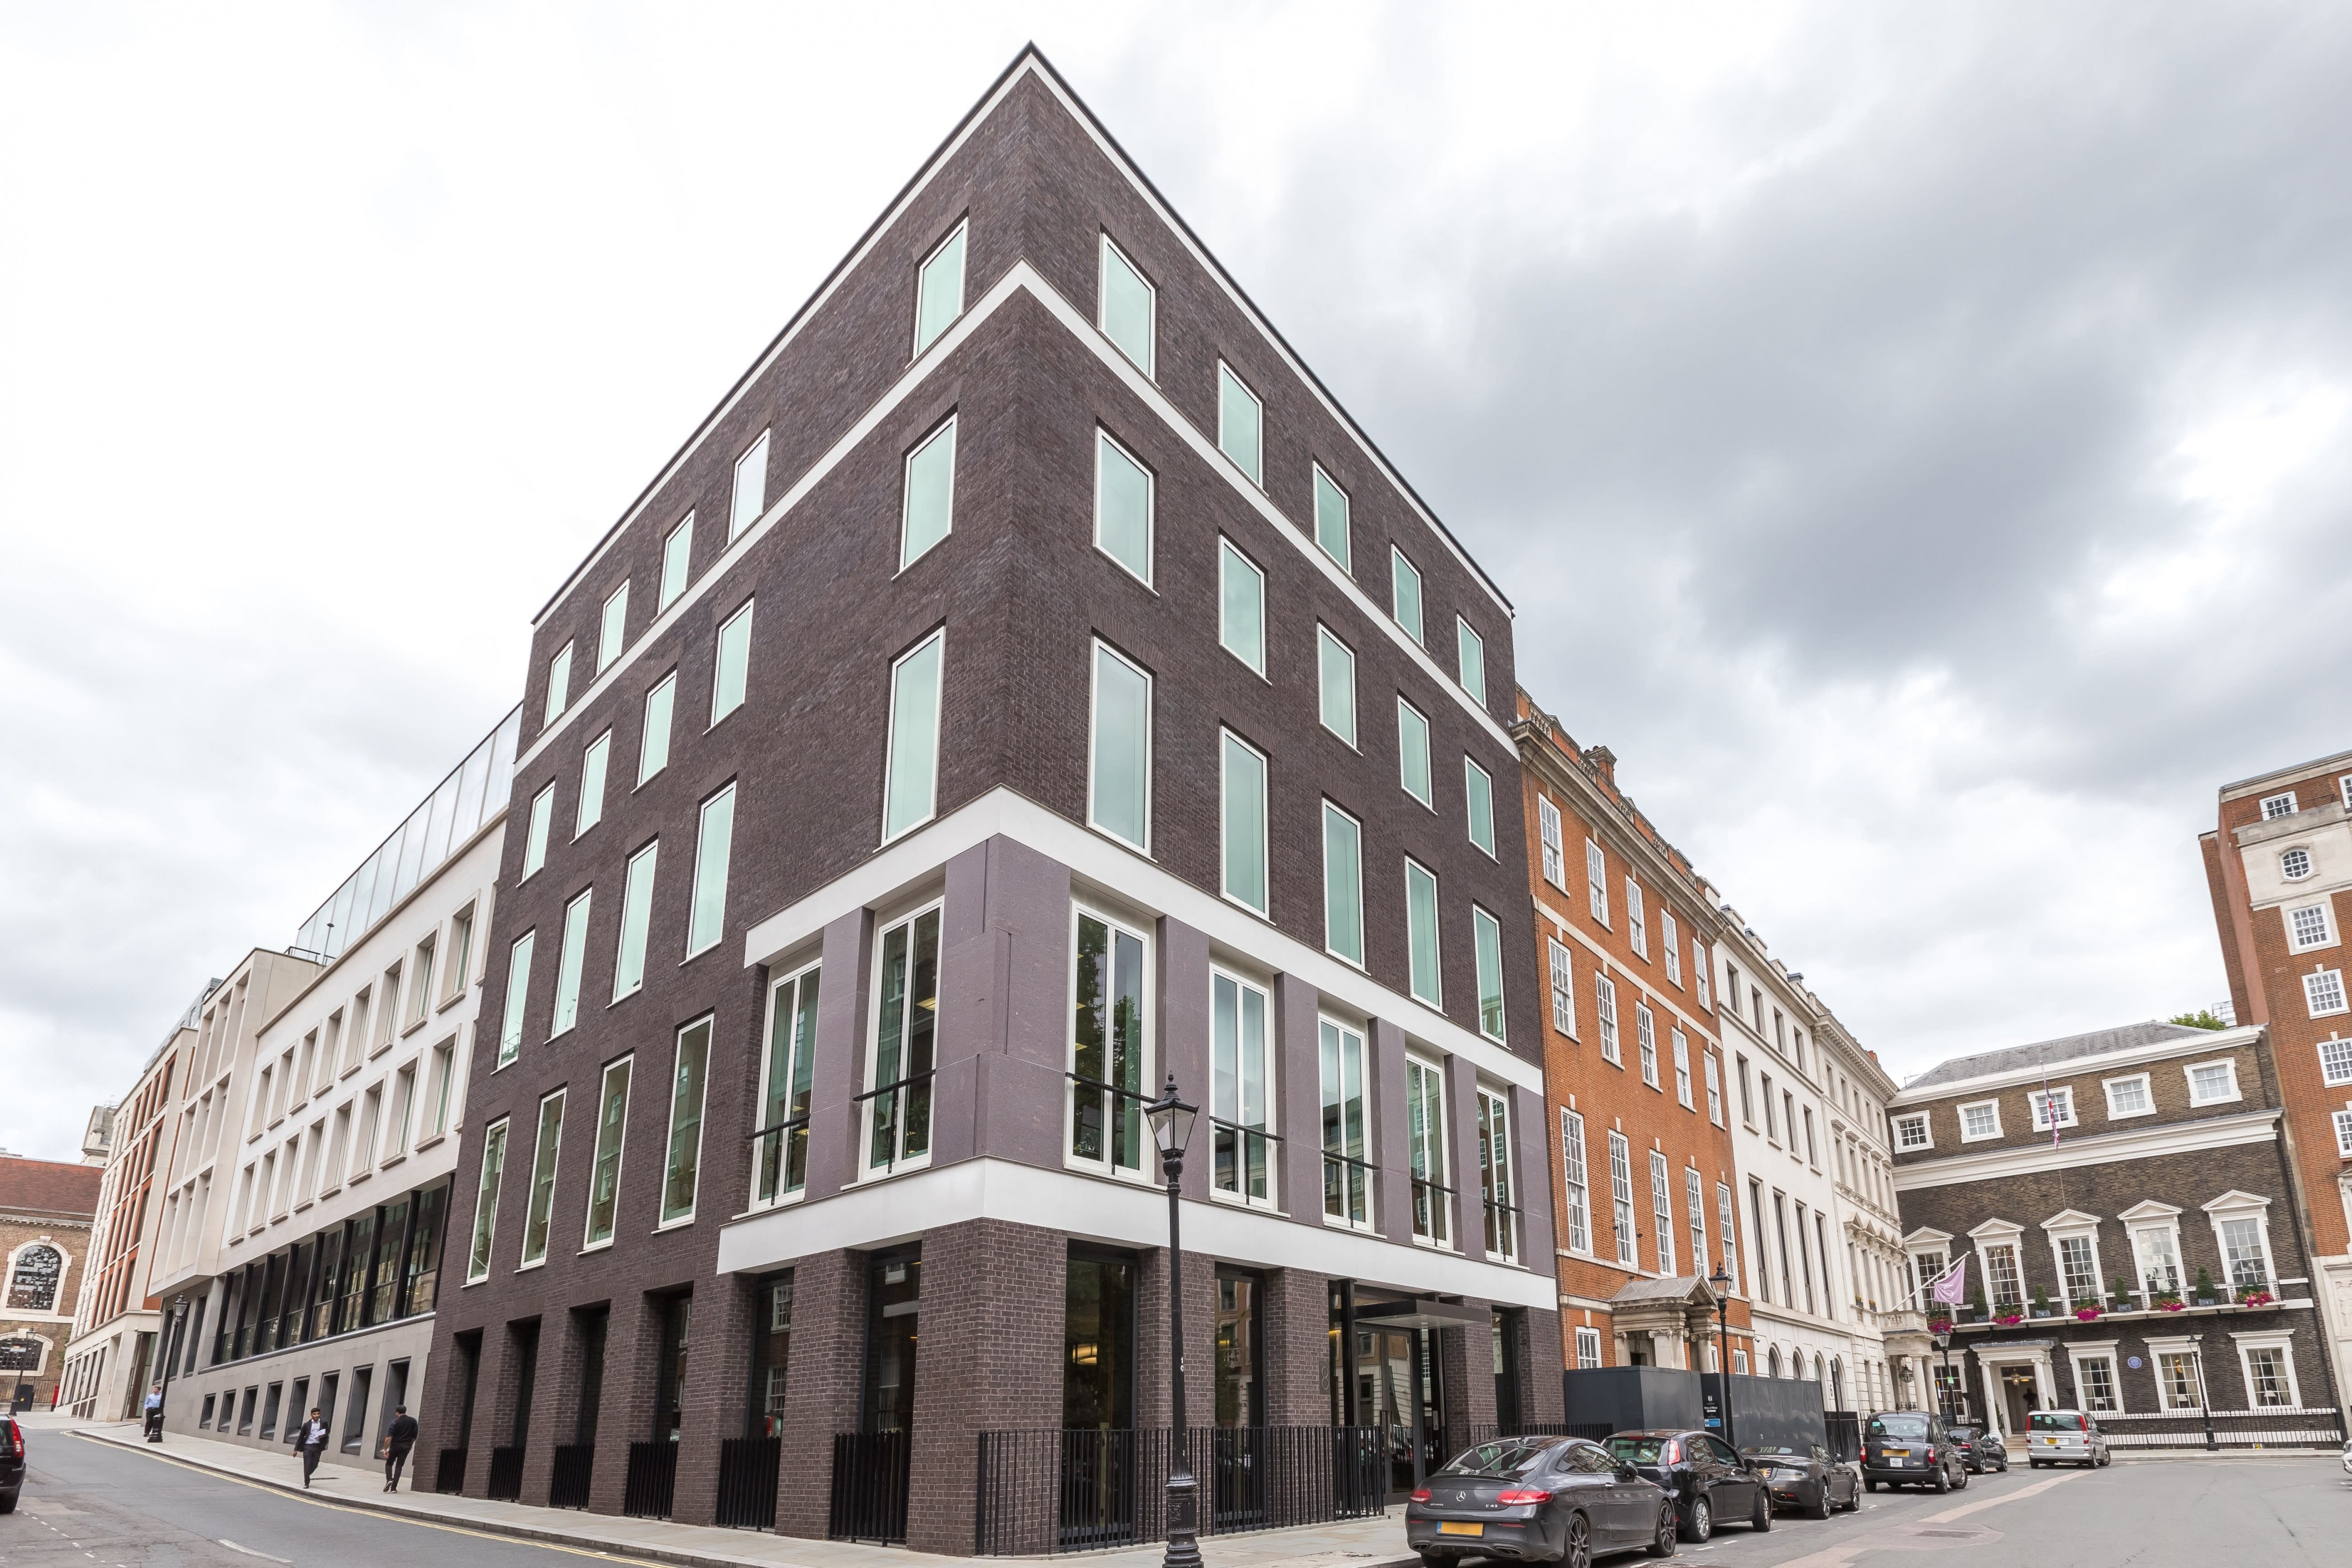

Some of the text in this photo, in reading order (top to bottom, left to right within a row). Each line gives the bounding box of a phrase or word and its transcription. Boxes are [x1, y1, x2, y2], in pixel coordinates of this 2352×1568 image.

[1944, 1284, 1954, 1299] 5
[1321, 1366, 1329, 1391] 8
[1830, 1384, 1833, 1397] 6
